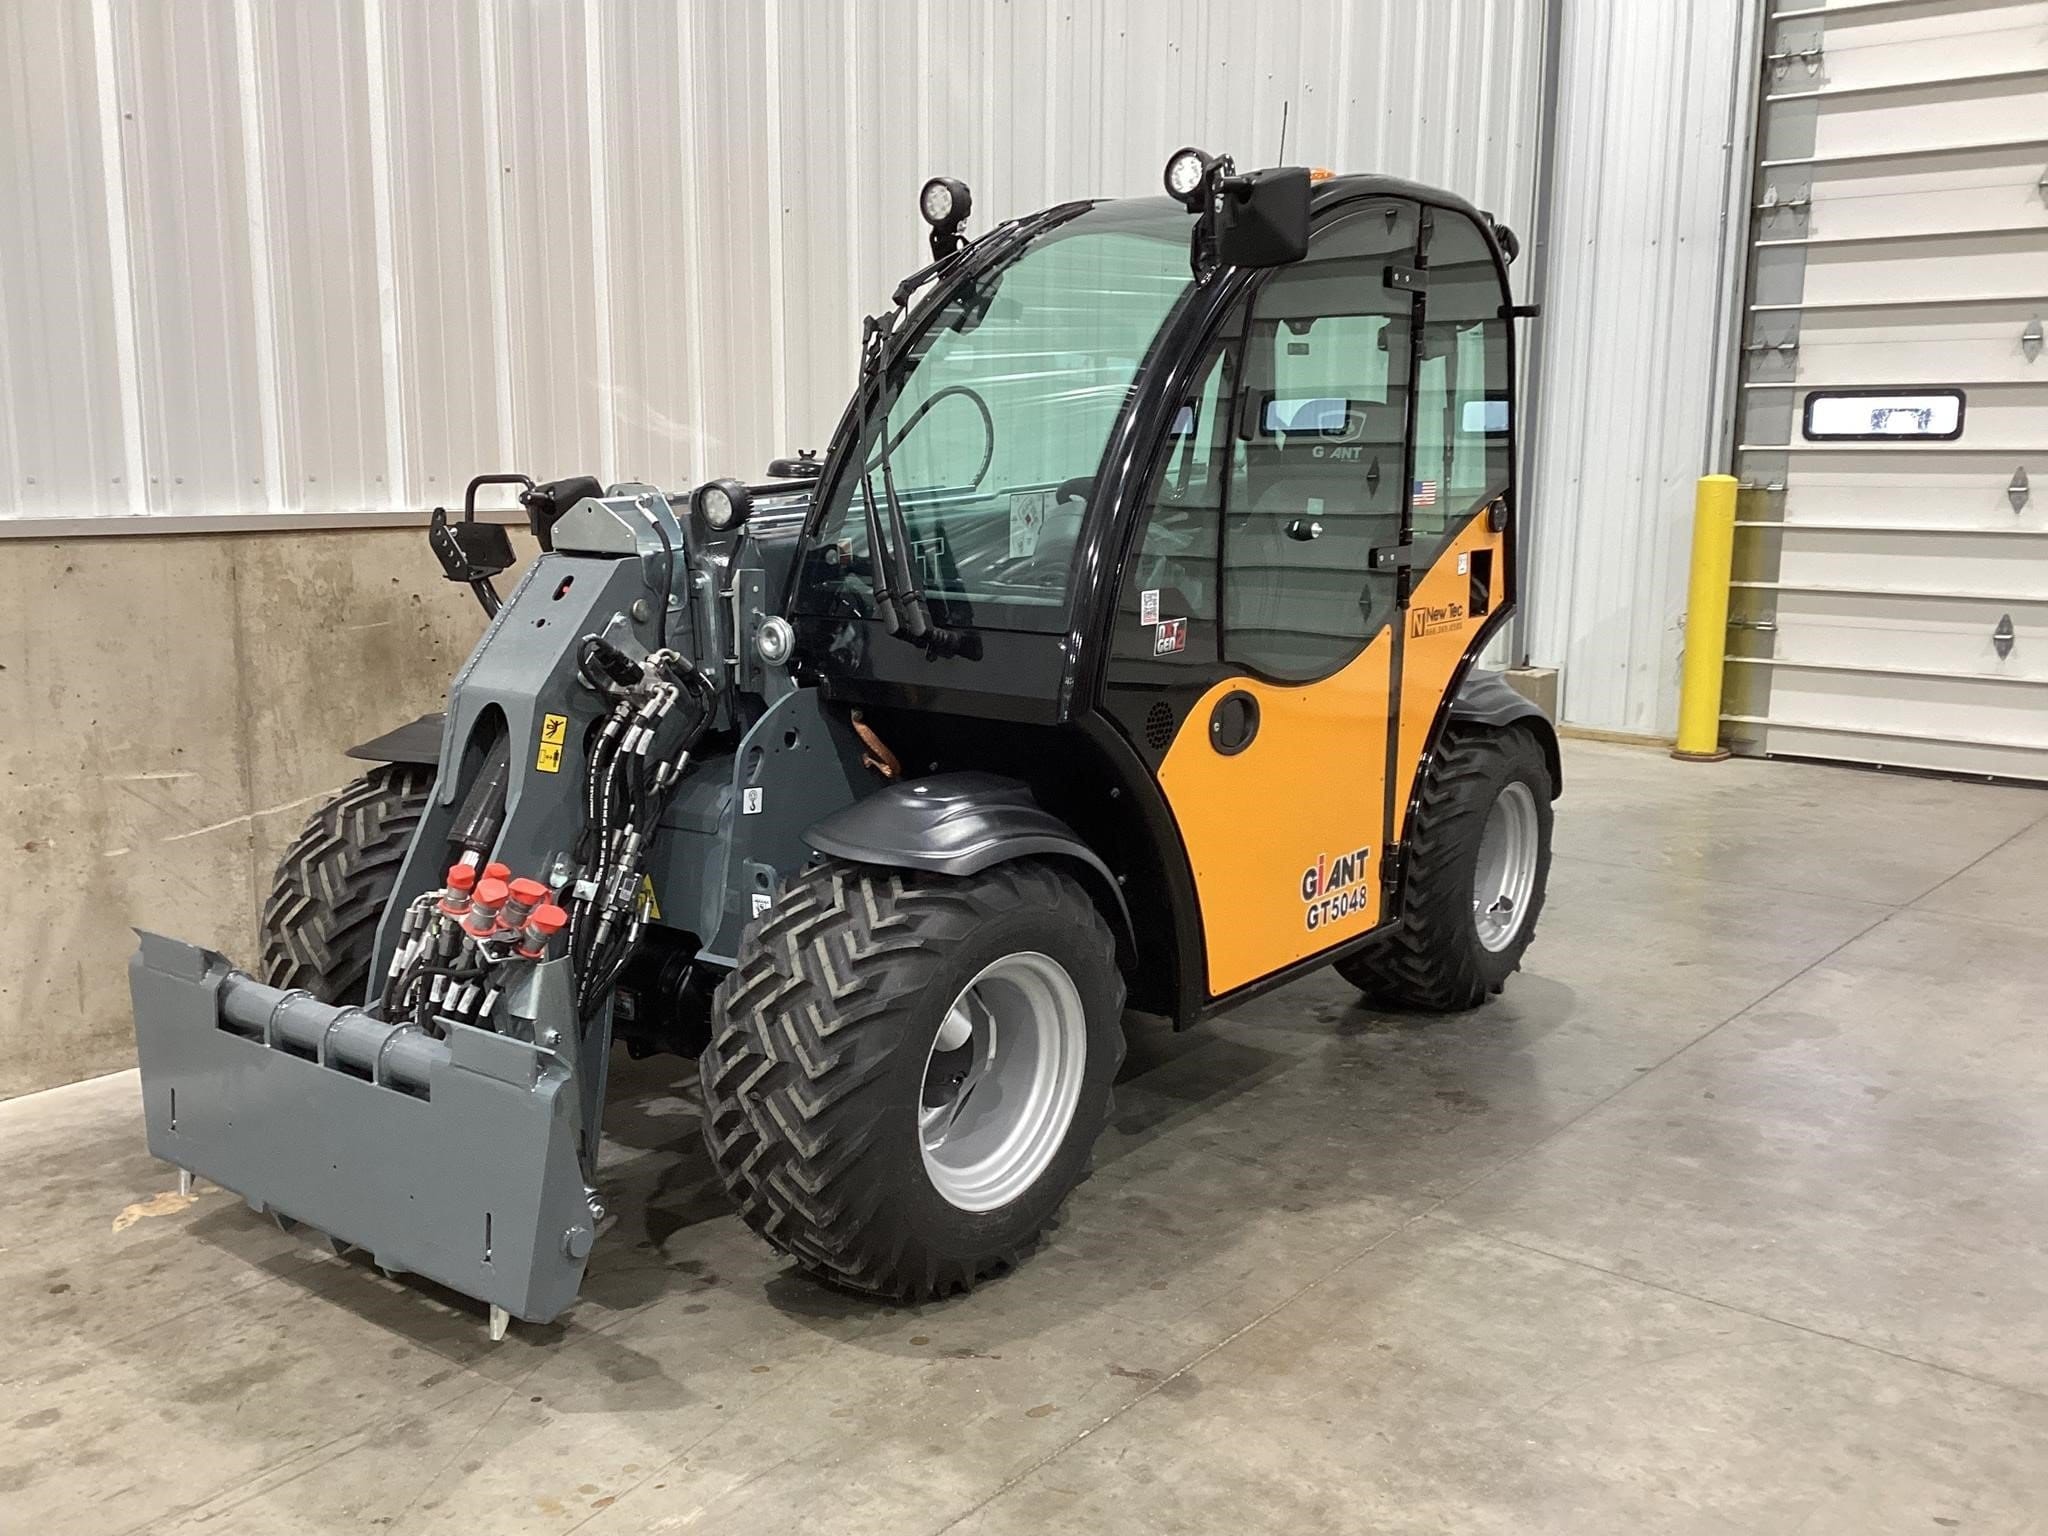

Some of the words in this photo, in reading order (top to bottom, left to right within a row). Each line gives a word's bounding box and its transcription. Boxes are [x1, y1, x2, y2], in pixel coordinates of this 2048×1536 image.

[1312, 446, 1363, 459] GANT
[1426, 606, 1447, 622] New
[1448, 603, 1463, 617] Tec
[1306, 885, 1367, 930] GT5048
